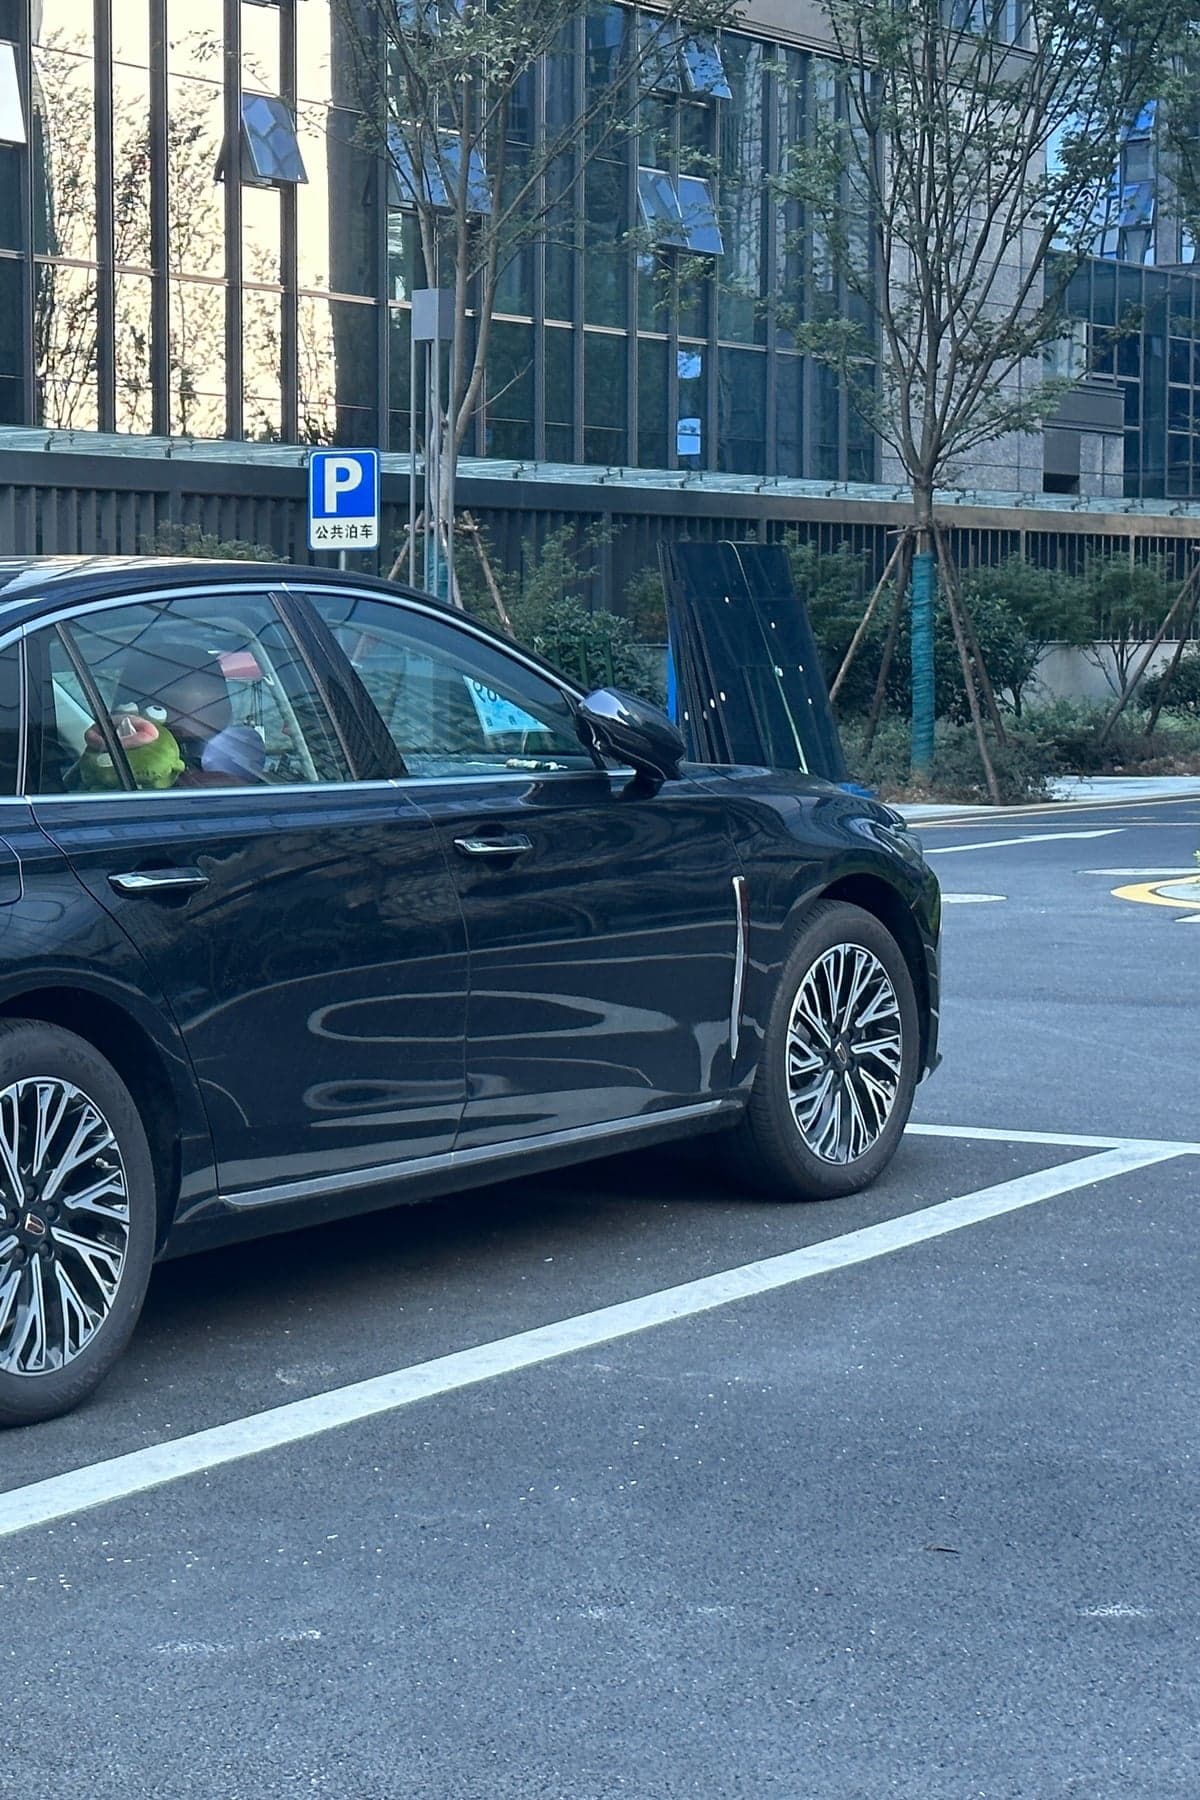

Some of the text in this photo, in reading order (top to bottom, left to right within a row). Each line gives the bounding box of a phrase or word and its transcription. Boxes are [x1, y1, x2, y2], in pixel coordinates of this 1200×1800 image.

[324, 457, 363, 513] P
[315, 524, 374, 539] 公共泊车
